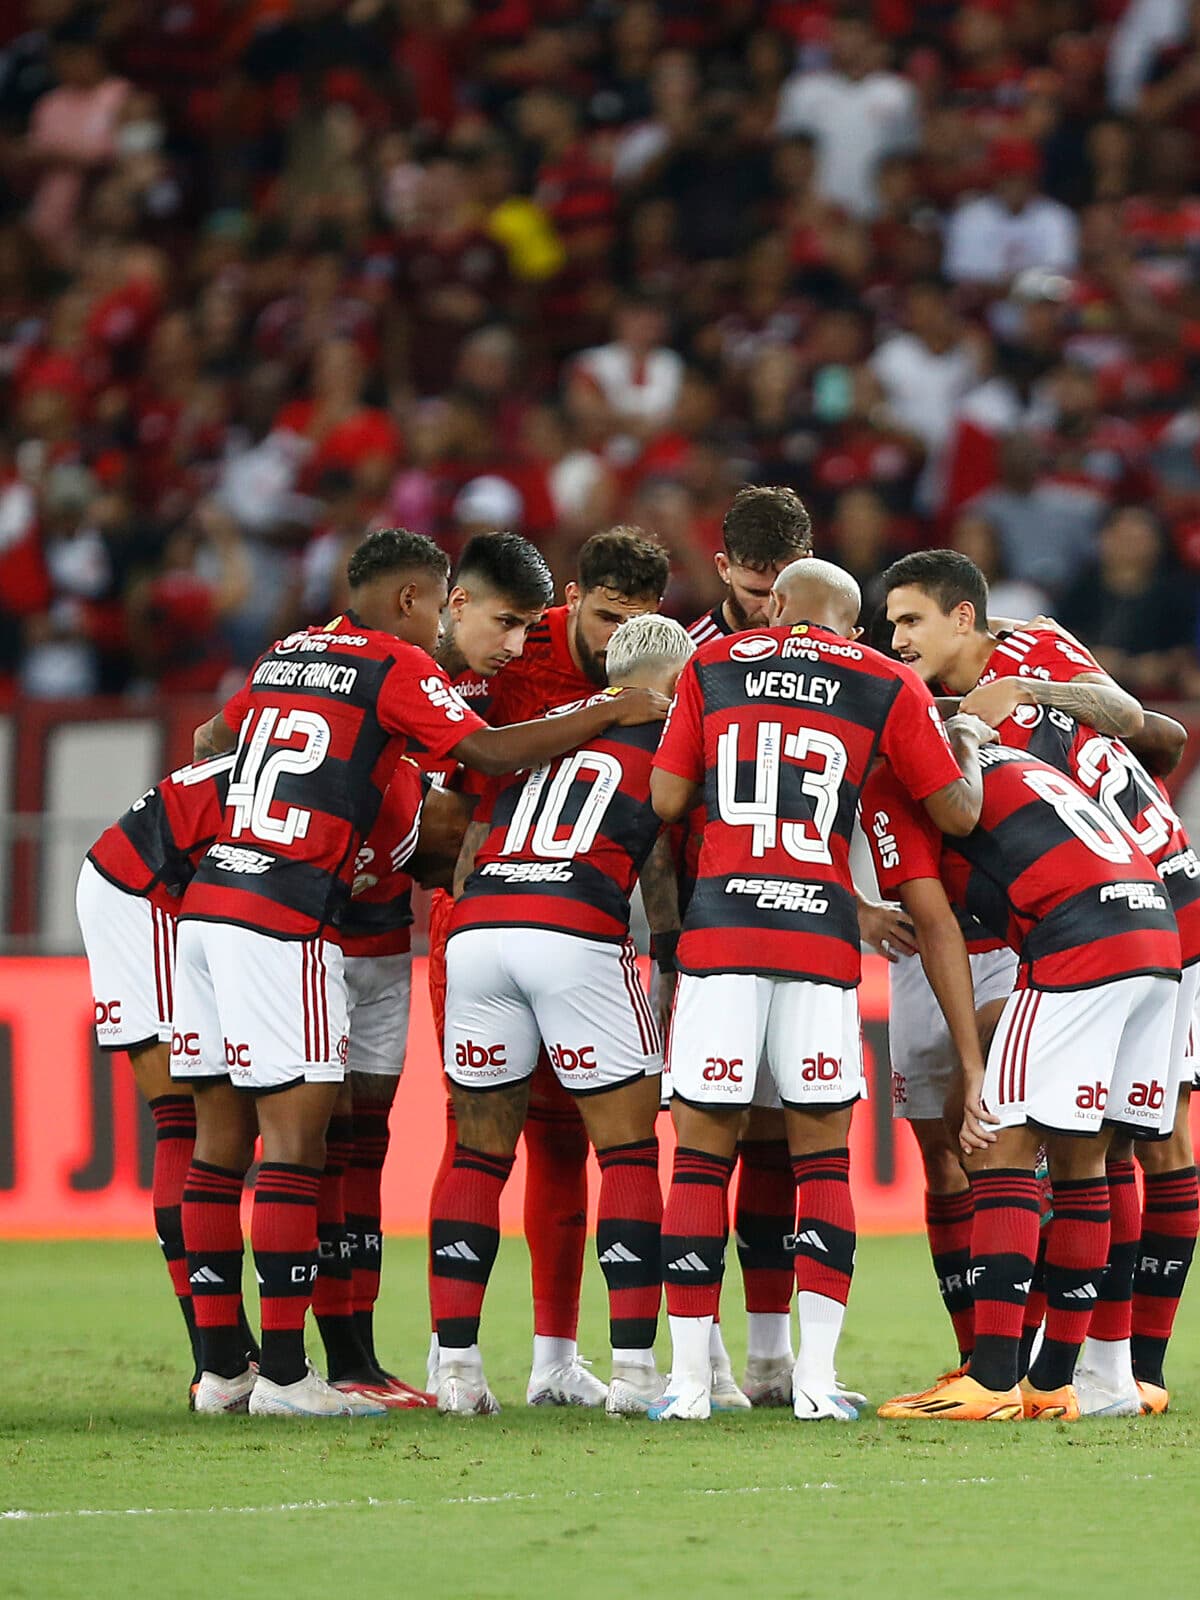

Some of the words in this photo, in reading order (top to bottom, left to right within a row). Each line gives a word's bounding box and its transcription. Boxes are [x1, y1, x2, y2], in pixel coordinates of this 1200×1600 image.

[781, 646, 820, 662] livre
[783, 636, 864, 661] mercado
[251, 660, 305, 686] ATHEUS
[297, 661, 358, 695] FRANÇA
[744, 671, 841, 706] WESLEY
[763, 737, 774, 757] TIM
[226, 707, 332, 845] 42
[498, 750, 623, 859] 10
[717, 721, 848, 865] 43
[1022, 769, 1134, 864] 8
[872, 810, 900, 869] elis
[480, 861, 572, 877] ASSIST
[504, 871, 574, 883] CARD
[724, 878, 824, 900] ASSIST
[1100, 882, 1157, 904] ASSIST
[1127, 895, 1167, 910] CARD
[756, 893, 829, 914] CARD
[456, 1039, 507, 1069] abc
[550, 1043, 597, 1071] abc
[801, 1052, 842, 1082] ab
